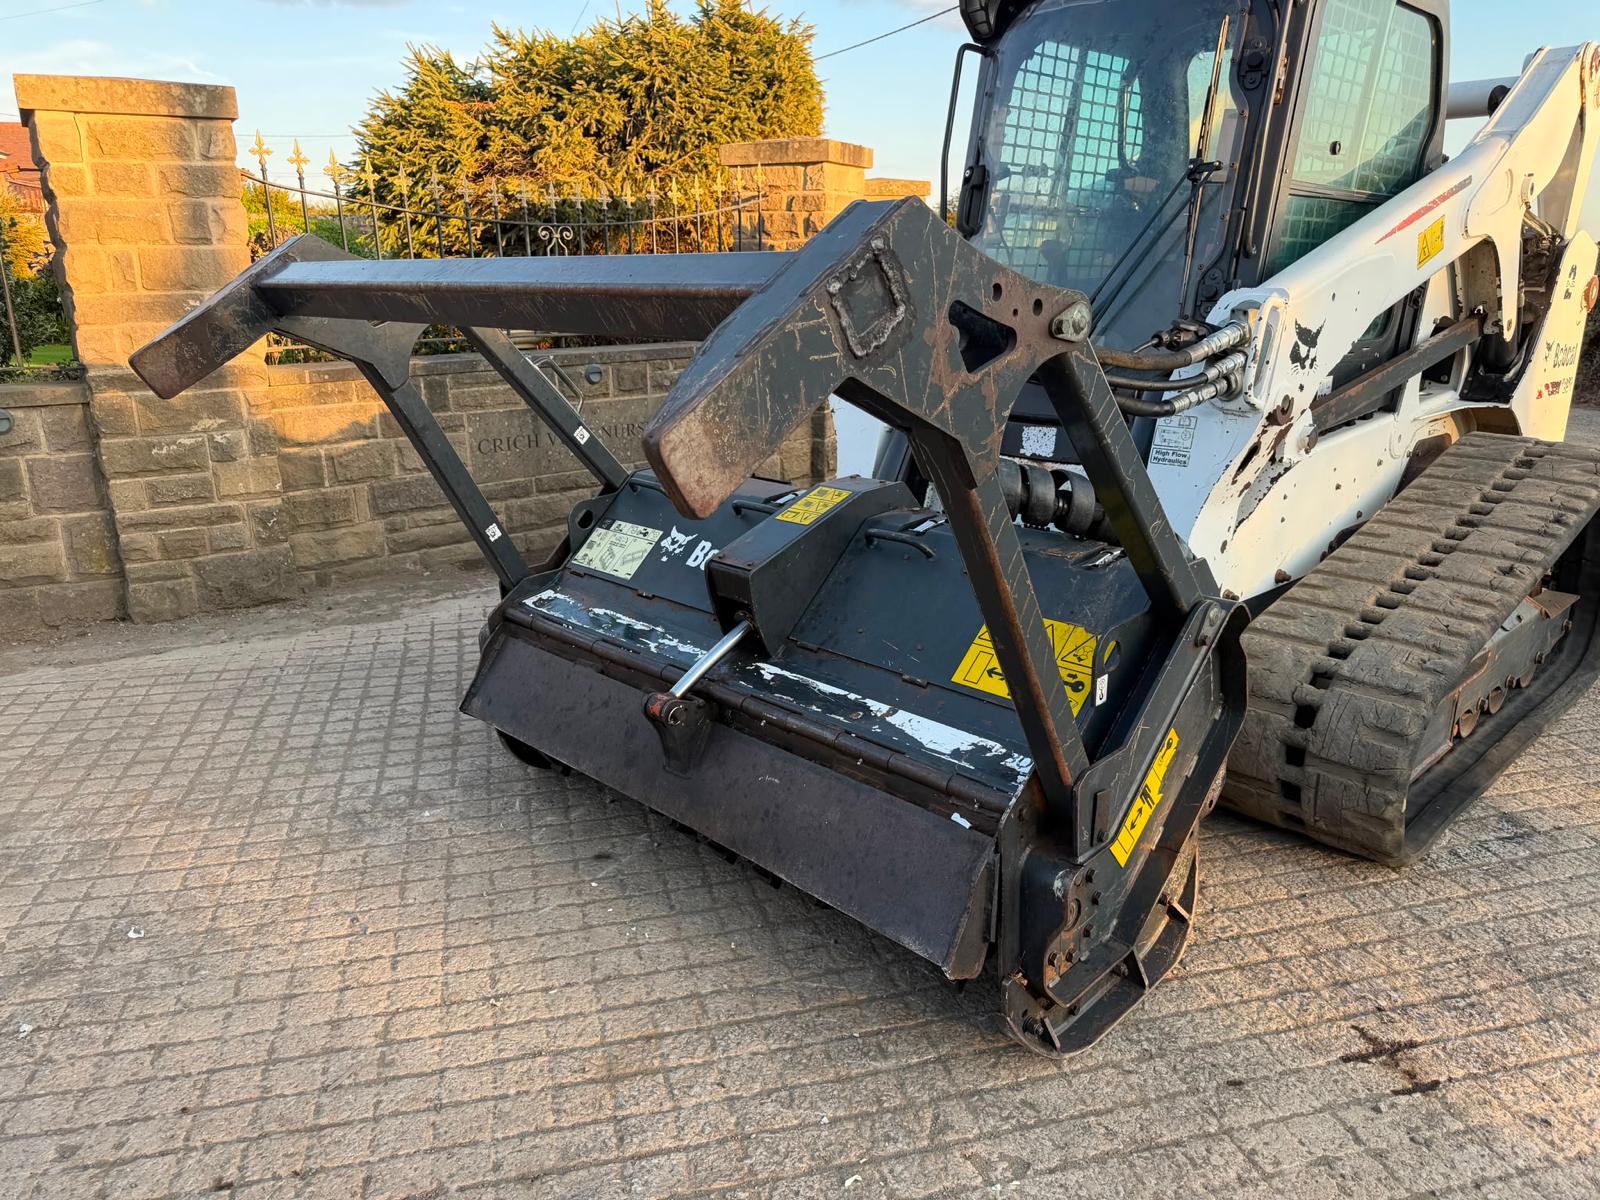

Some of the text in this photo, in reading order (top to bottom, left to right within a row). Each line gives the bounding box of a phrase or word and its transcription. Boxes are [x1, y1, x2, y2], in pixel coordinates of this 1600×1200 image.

[478, 432, 539, 455] CRICH
[601, 421, 648, 438] NURS
[1152, 456, 1187, 465] Hydraulics
